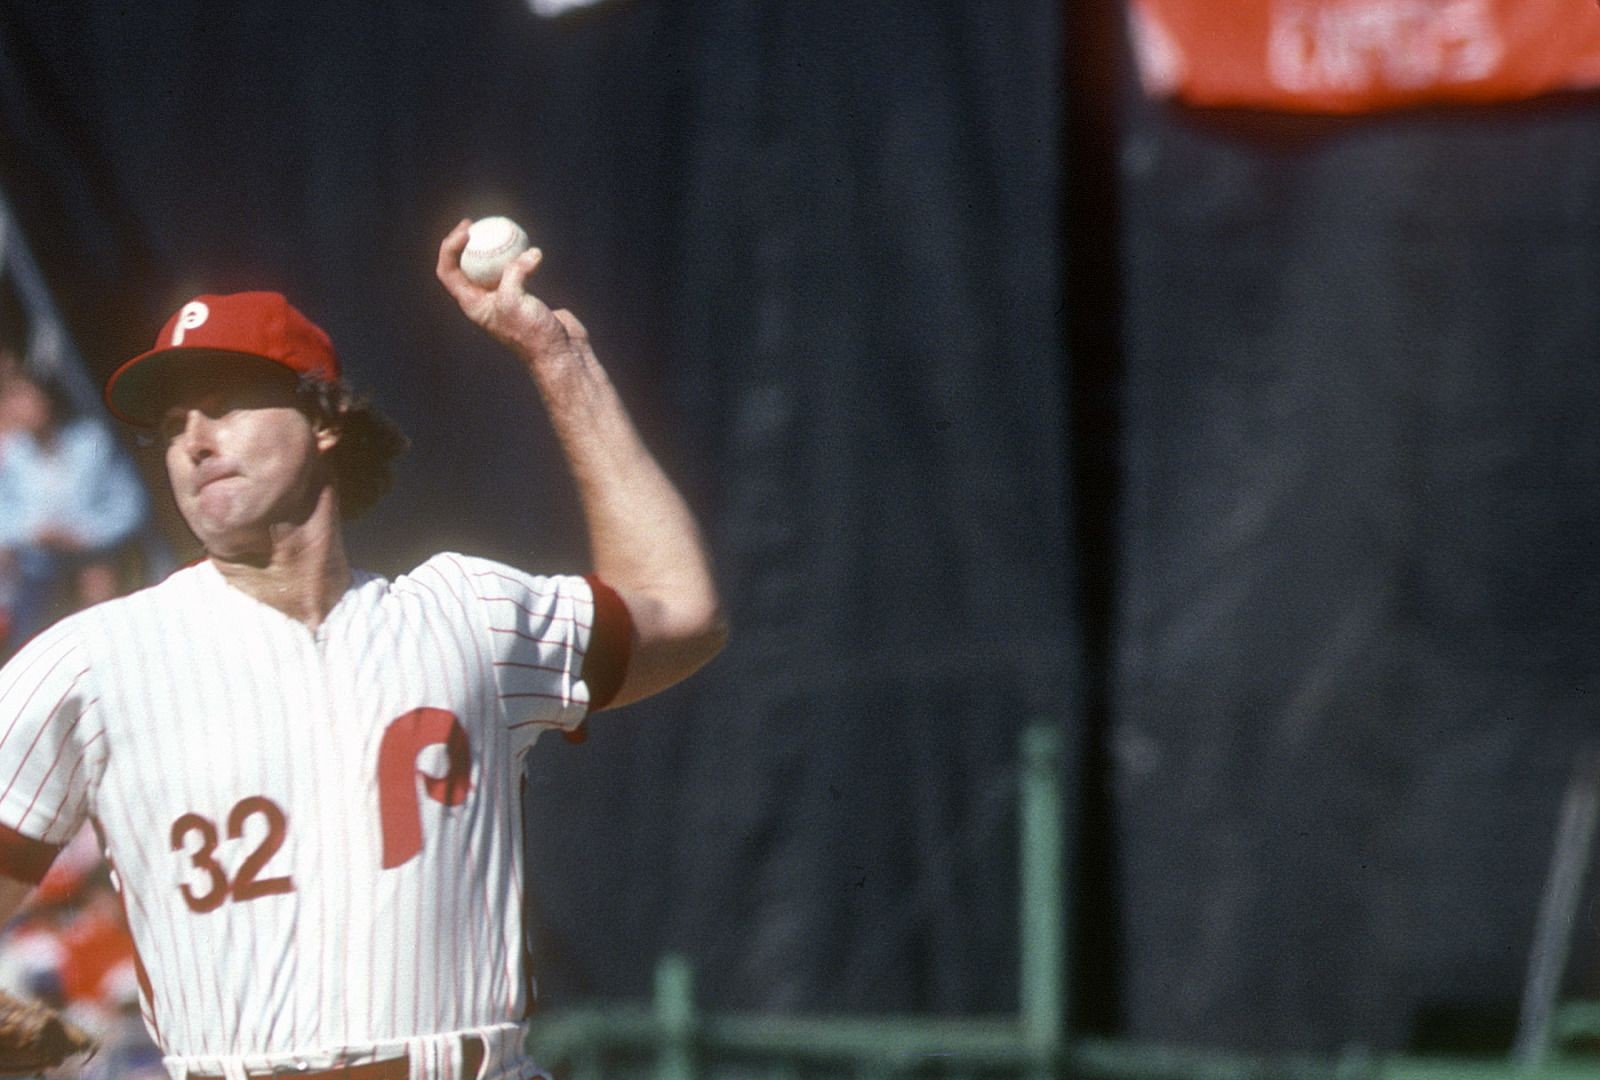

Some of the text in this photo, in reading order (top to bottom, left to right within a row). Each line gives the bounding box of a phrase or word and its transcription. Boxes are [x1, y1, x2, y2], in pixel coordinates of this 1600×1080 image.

[171, 301, 209, 346] P
[378, 706, 471, 869] P
[171, 796, 296, 913] 32
